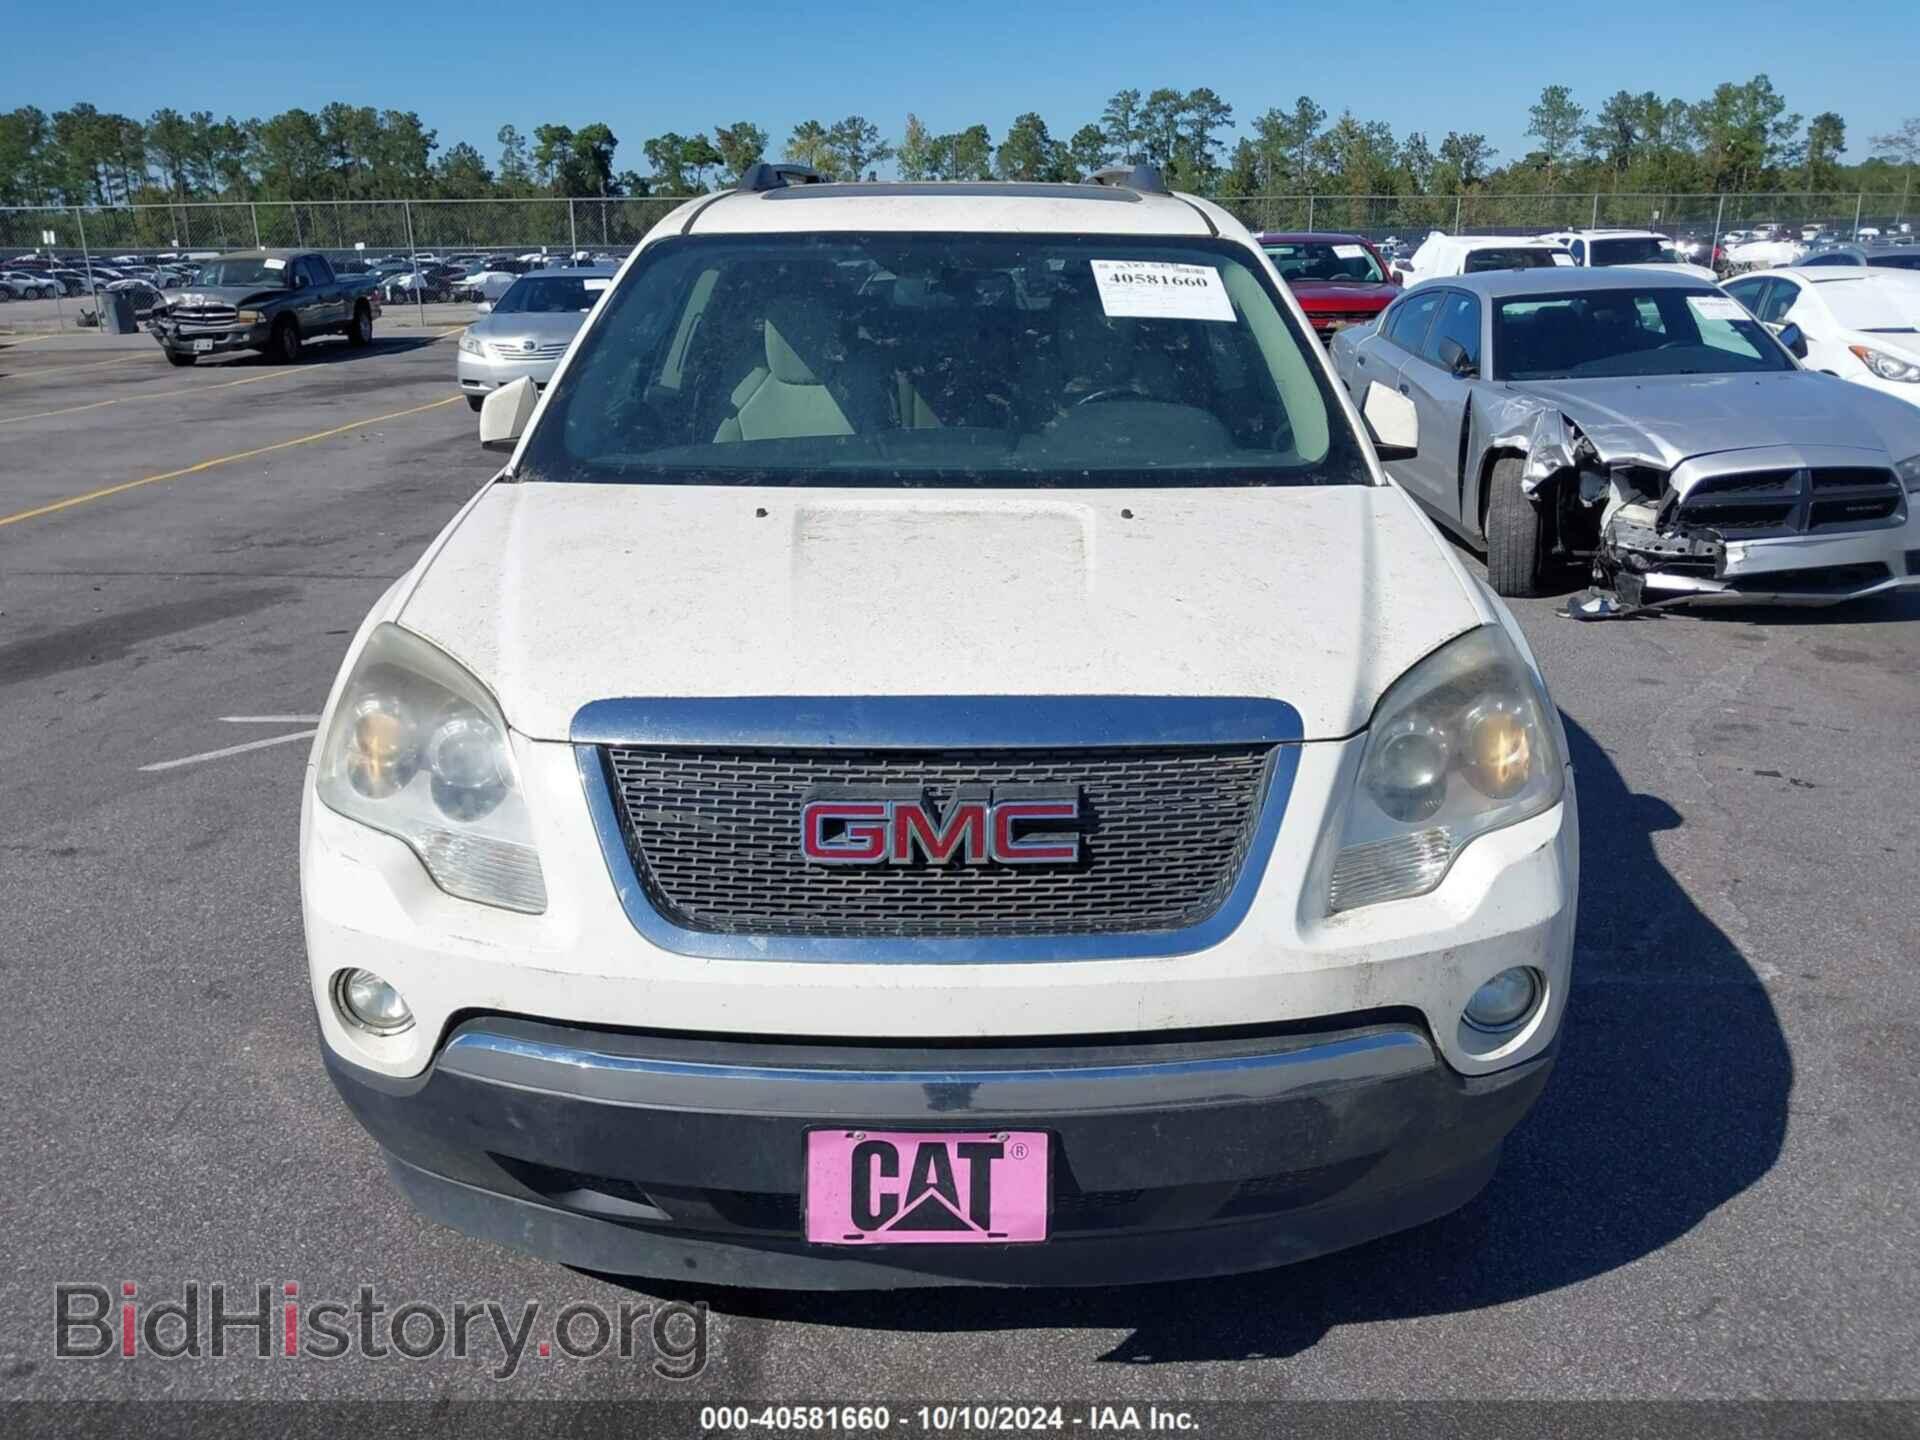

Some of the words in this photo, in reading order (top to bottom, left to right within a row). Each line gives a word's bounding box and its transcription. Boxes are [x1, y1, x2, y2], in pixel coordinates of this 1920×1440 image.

[1110, 272, 1209, 288] 40581660
[801, 799, 1079, 864] GMC
[851, 1140, 1004, 1231] CAT
